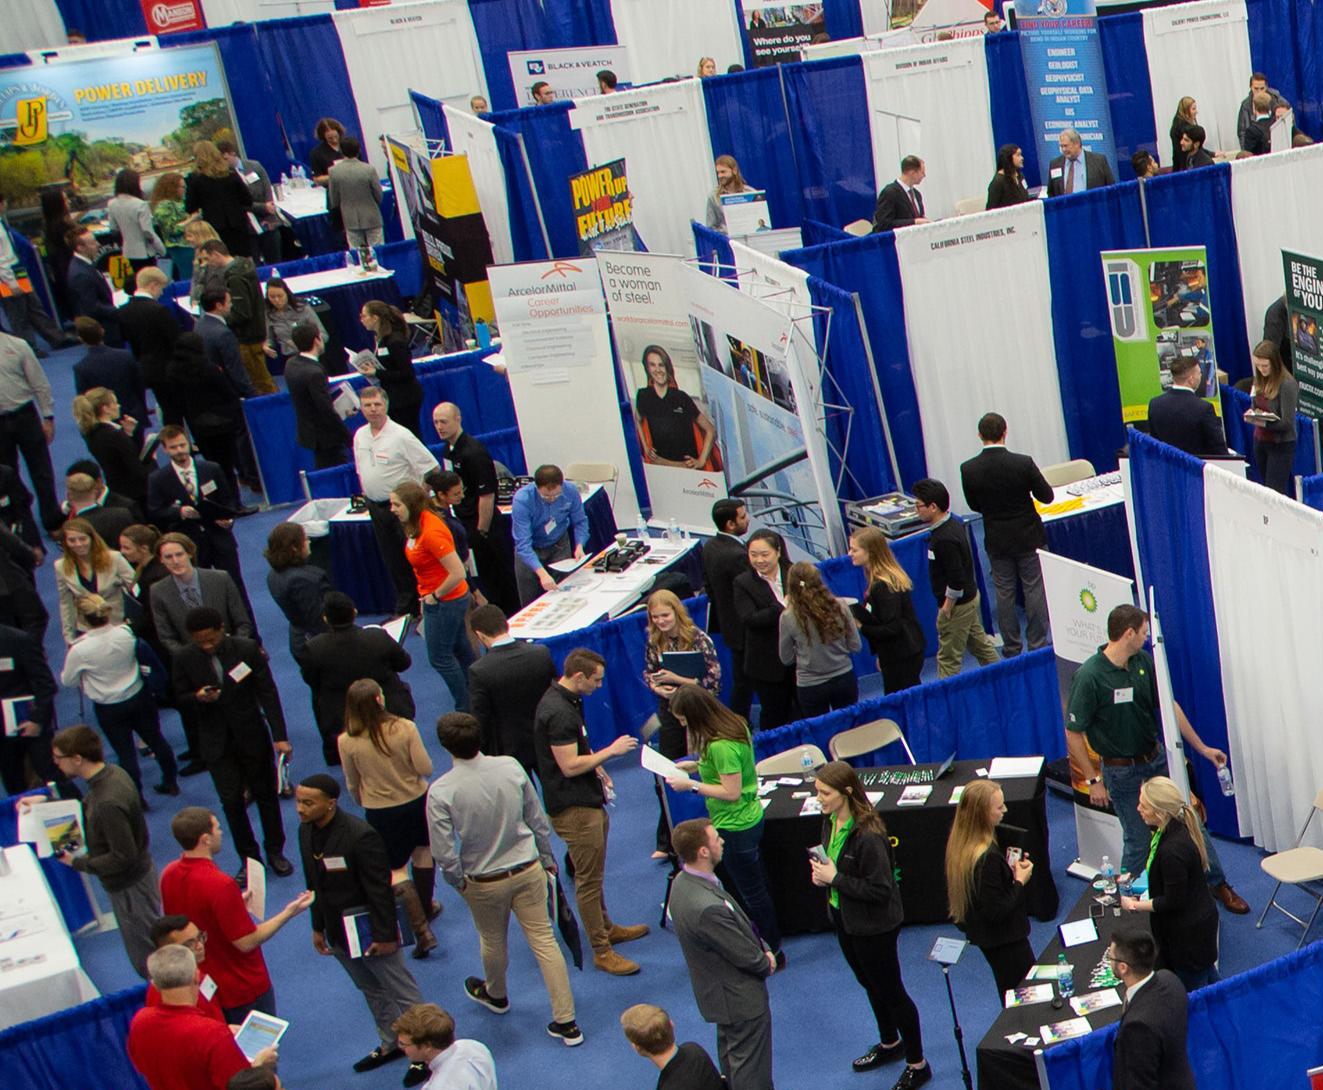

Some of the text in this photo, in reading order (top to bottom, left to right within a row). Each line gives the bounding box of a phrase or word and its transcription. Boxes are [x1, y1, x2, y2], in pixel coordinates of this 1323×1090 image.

[753, 34, 811, 46] Where do you
[755, 48, 770, 56] see
[547, 59, 612, 71] BLACK VEATCH
[75, 71, 208, 104] POWER DELIVERY
[571, 167, 616, 210] POWER
[931, 237, 960, 250] CALIFORNIA
[960, 234, 975, 245] STEEL
[606, 261, 651, 276] Become
[1291, 261, 1317, 279] BE THE
[508, 282, 577, 297] ArcelorMittal
[610, 280, 662, 291] a woman
[527, 297, 560, 308] Career
[612, 290, 655, 305] of steel.
[529, 304, 595, 320] Opportunities
